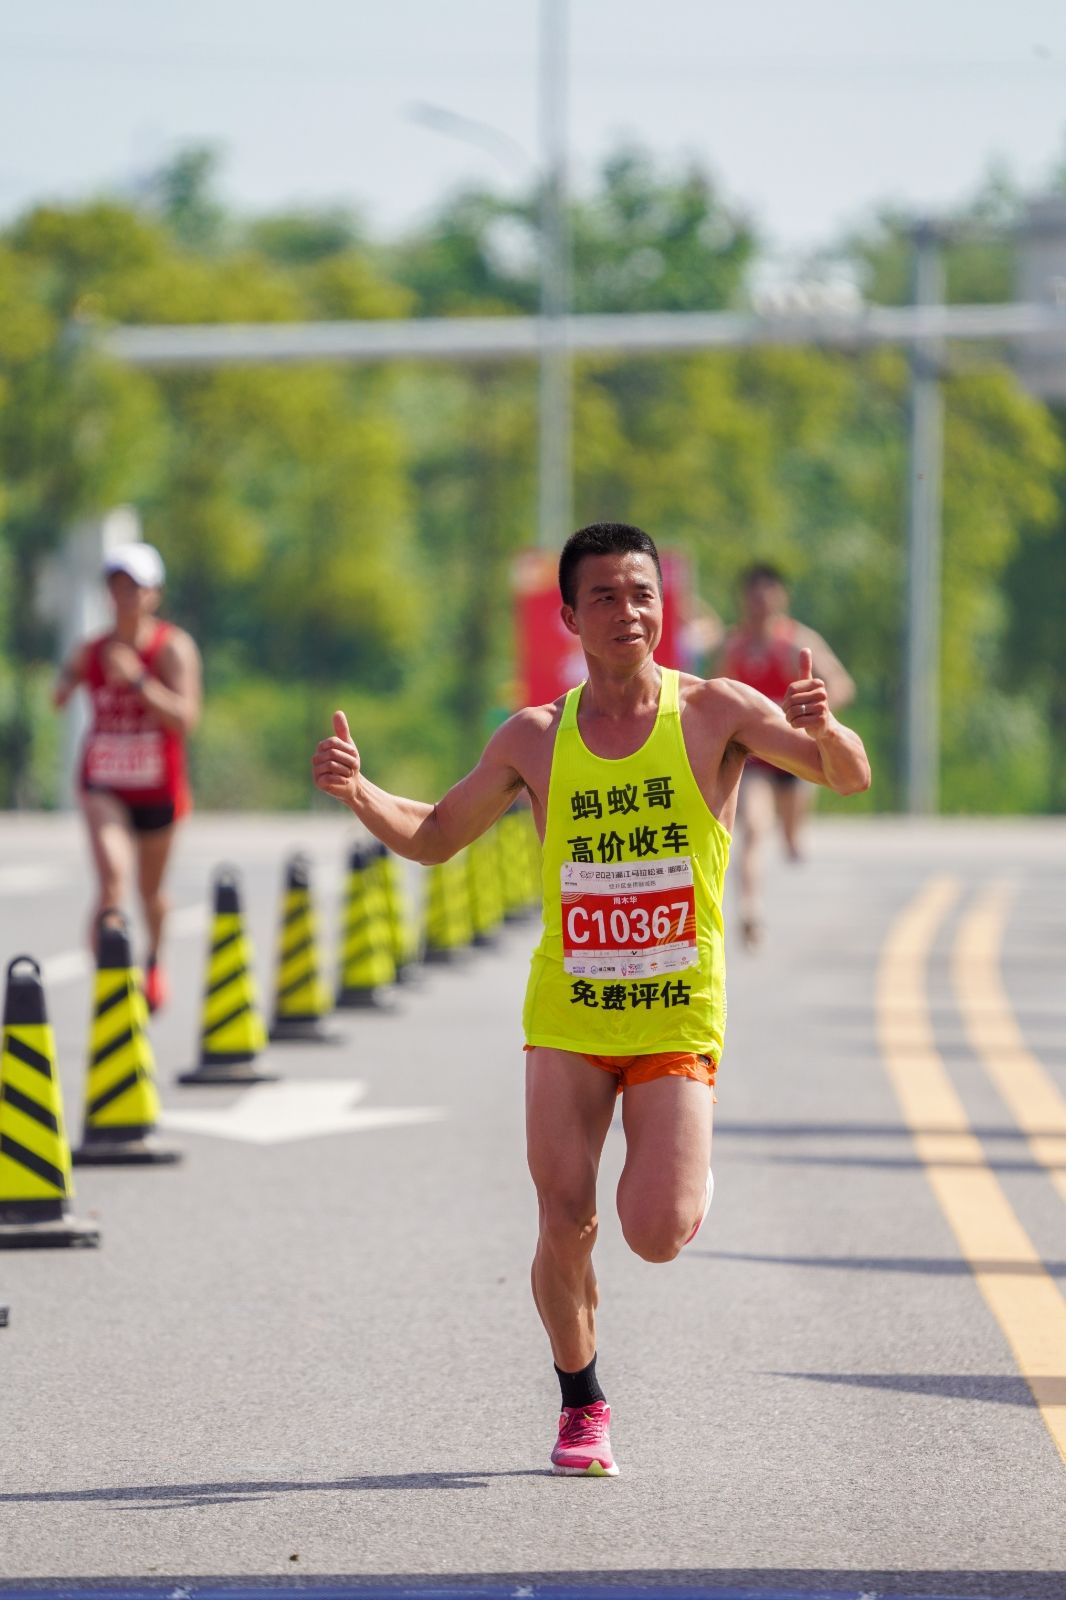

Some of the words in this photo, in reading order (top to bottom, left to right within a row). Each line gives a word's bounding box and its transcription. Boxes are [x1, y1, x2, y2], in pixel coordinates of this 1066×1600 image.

[570, 776, 675, 821] 蚂蚁哥
[567, 822, 689, 864] 高价收车
[567, 902, 689, 944] C10367
[570, 979, 692, 1011] 免费评估
